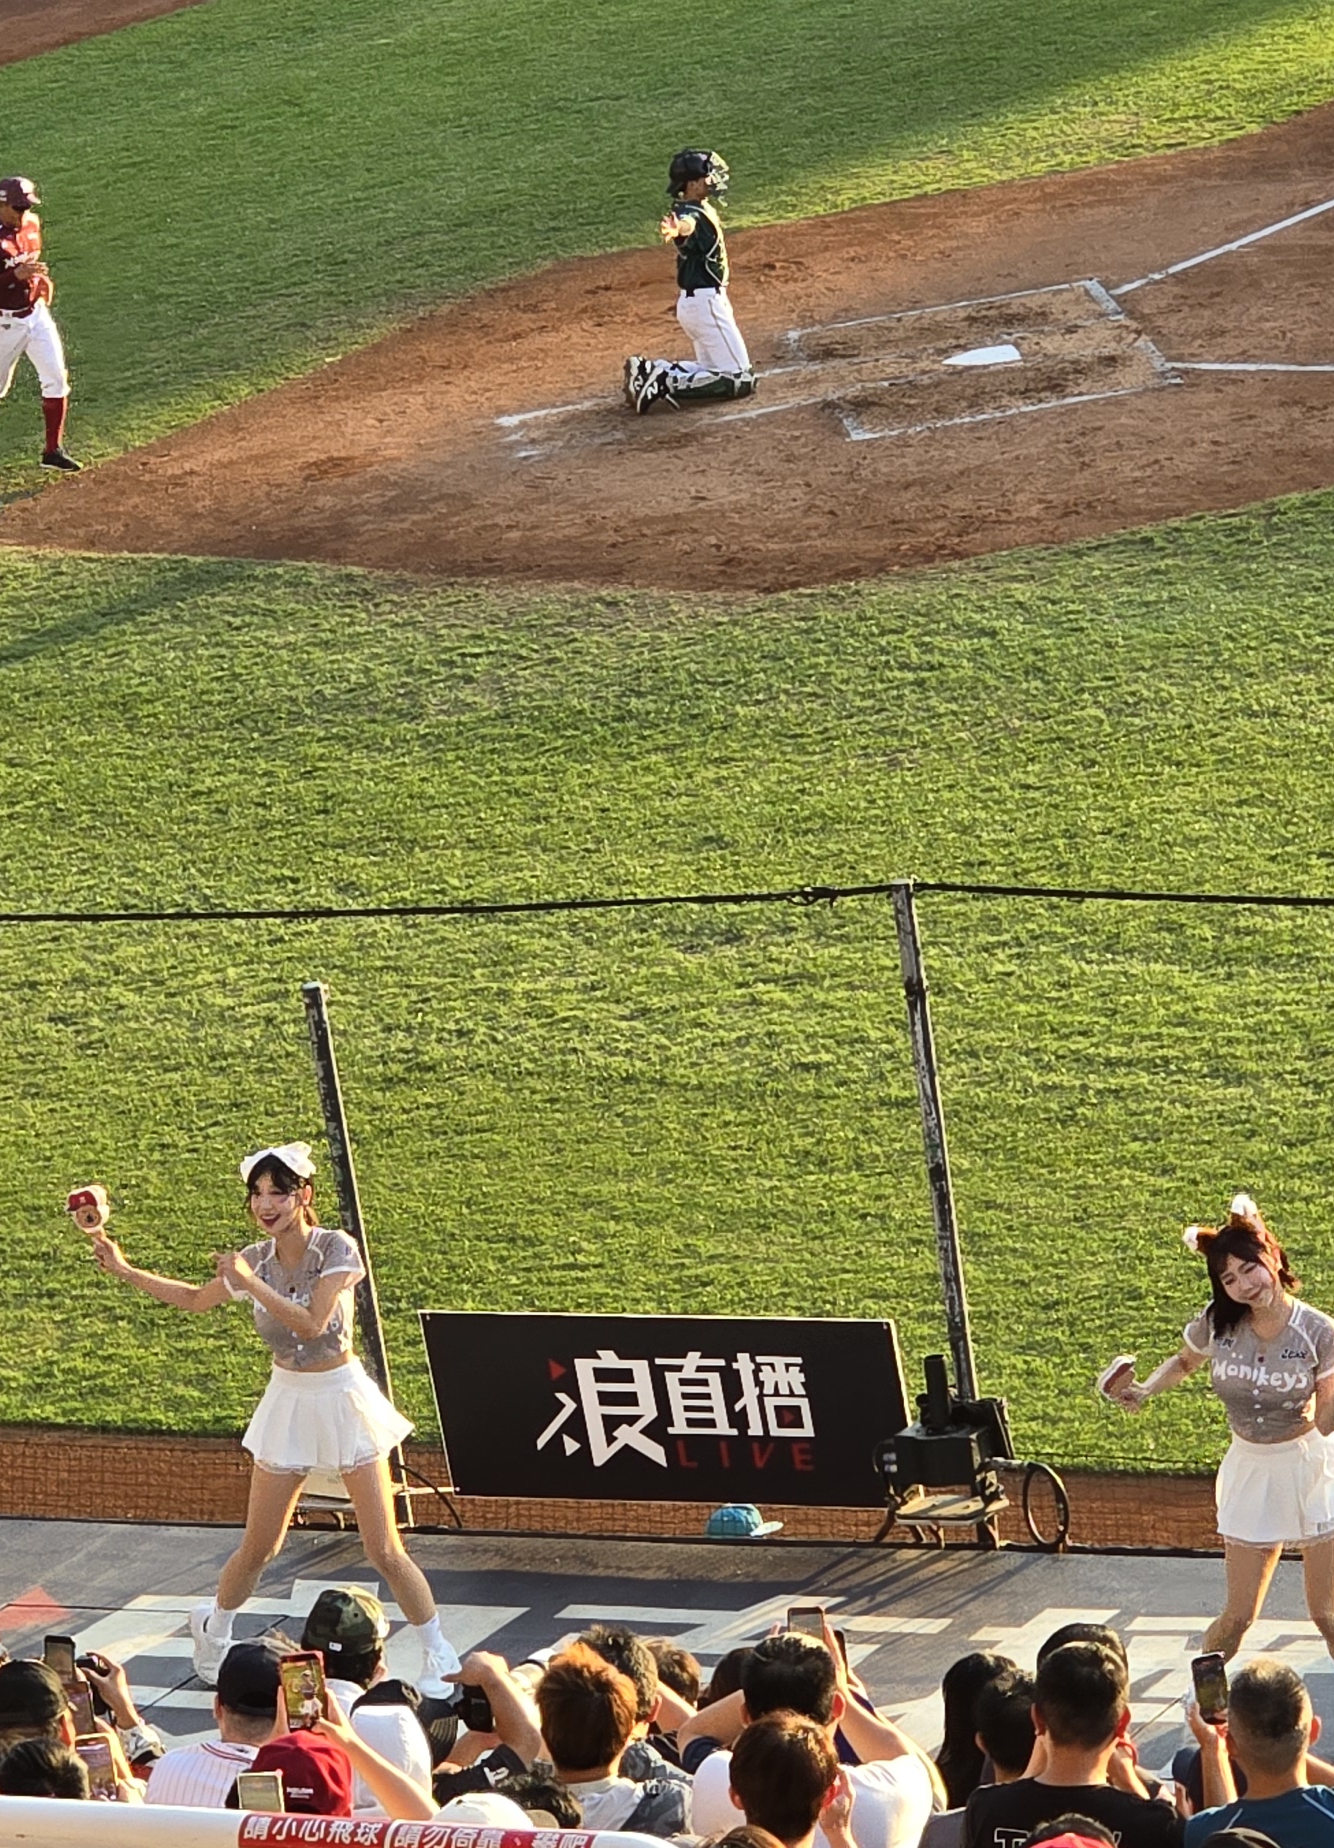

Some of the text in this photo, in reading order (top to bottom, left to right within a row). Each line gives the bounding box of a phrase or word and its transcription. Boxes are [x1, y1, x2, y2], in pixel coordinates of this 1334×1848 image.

[536, 1350, 815, 1468] 浪直播
[676, 1440, 815, 1471] LIVE
[244, 1815, 383, 1846] 請小心飛球
